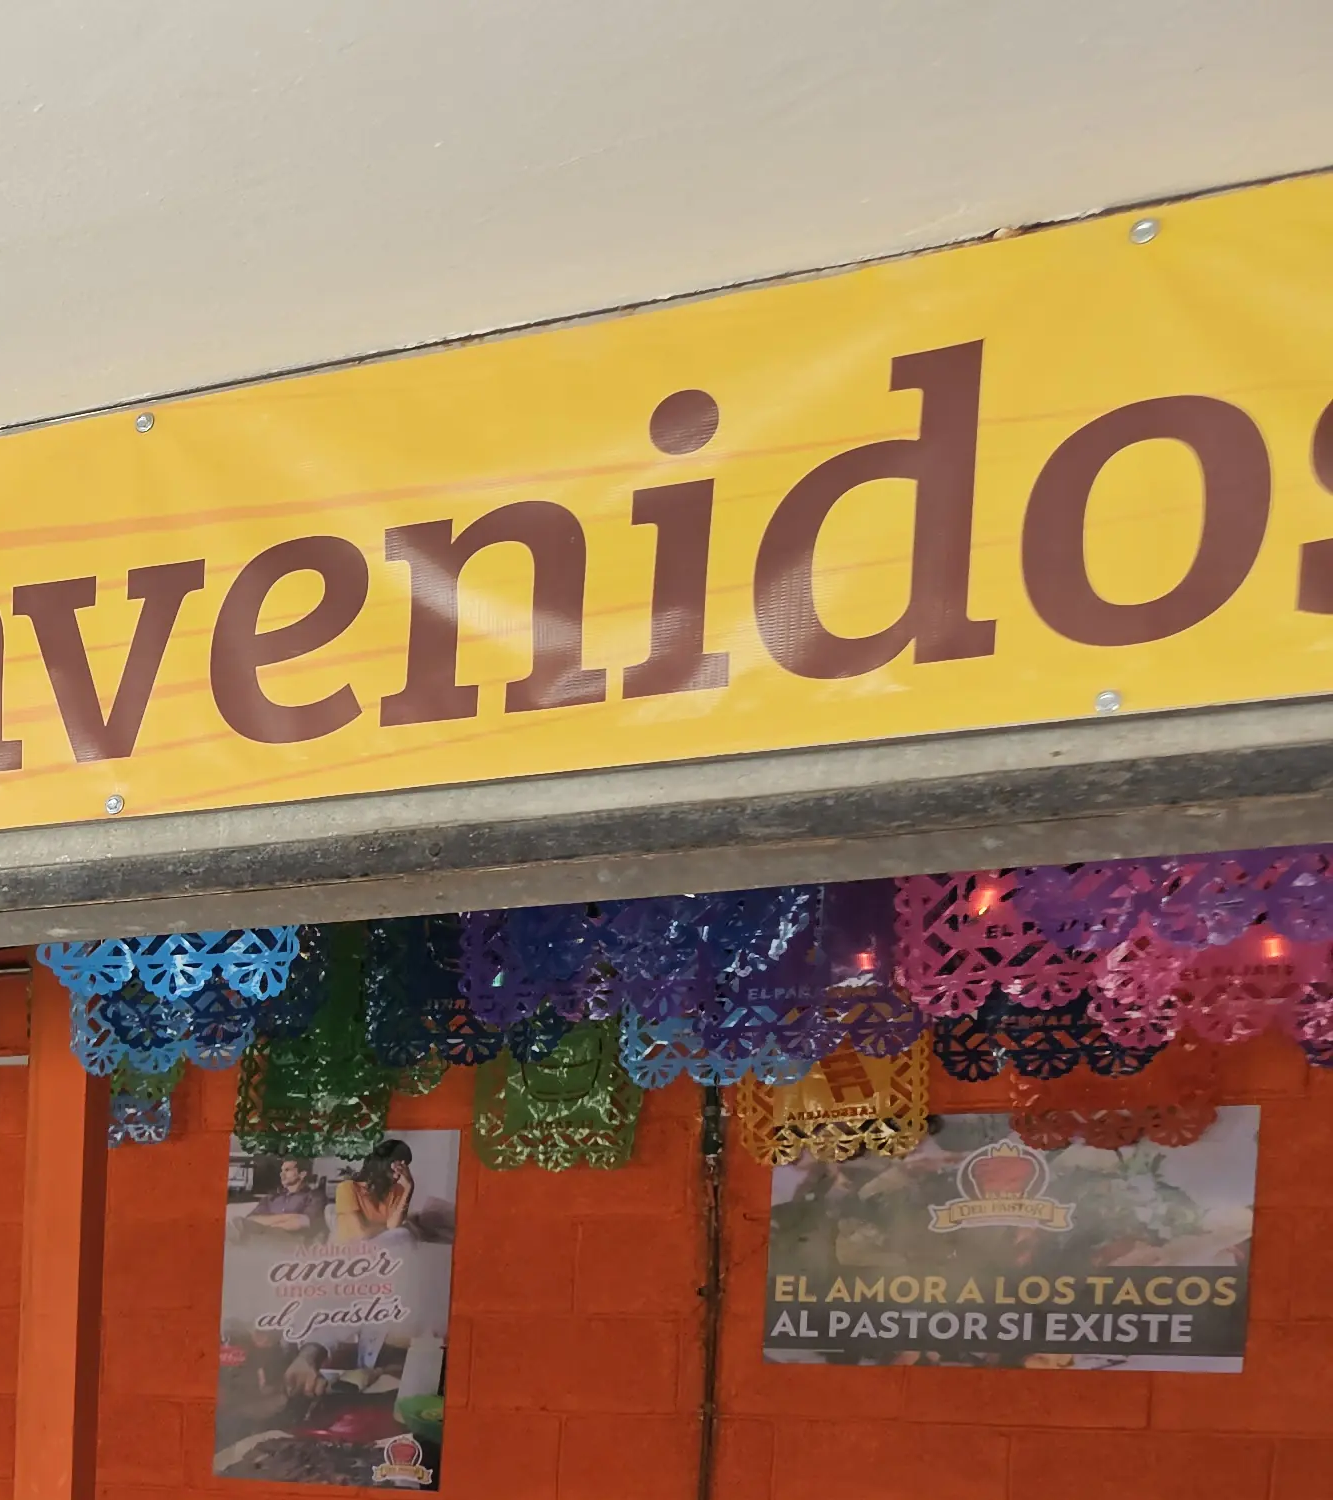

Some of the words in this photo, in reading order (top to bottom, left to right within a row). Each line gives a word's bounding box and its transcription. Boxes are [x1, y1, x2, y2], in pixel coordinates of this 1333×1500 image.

[958, 1203, 987, 1218] DEL
[991, 1201, 1046, 1218] PASTOR
[269, 1251, 401, 1283] amor
[275, 1282, 328, 1298] unos
[334, 1281, 393, 1297] tacos
[774, 1275, 817, 1302] EL
[827, 1276, 948, 1304] AMOR
[955, 1276, 984, 1304] A
[995, 1276, 1076, 1305] LOS
[1086, 1276, 1238, 1307] TACOS
[256, 1301, 300, 1329] al
[286, 1296, 407, 1340] pastor
[770, 1310, 819, 1338] AL
[828, 1310, 988, 1341] PASTOR
[997, 1312, 1033, 1341] SI
[1044, 1312, 1194, 1343] EXISTE
